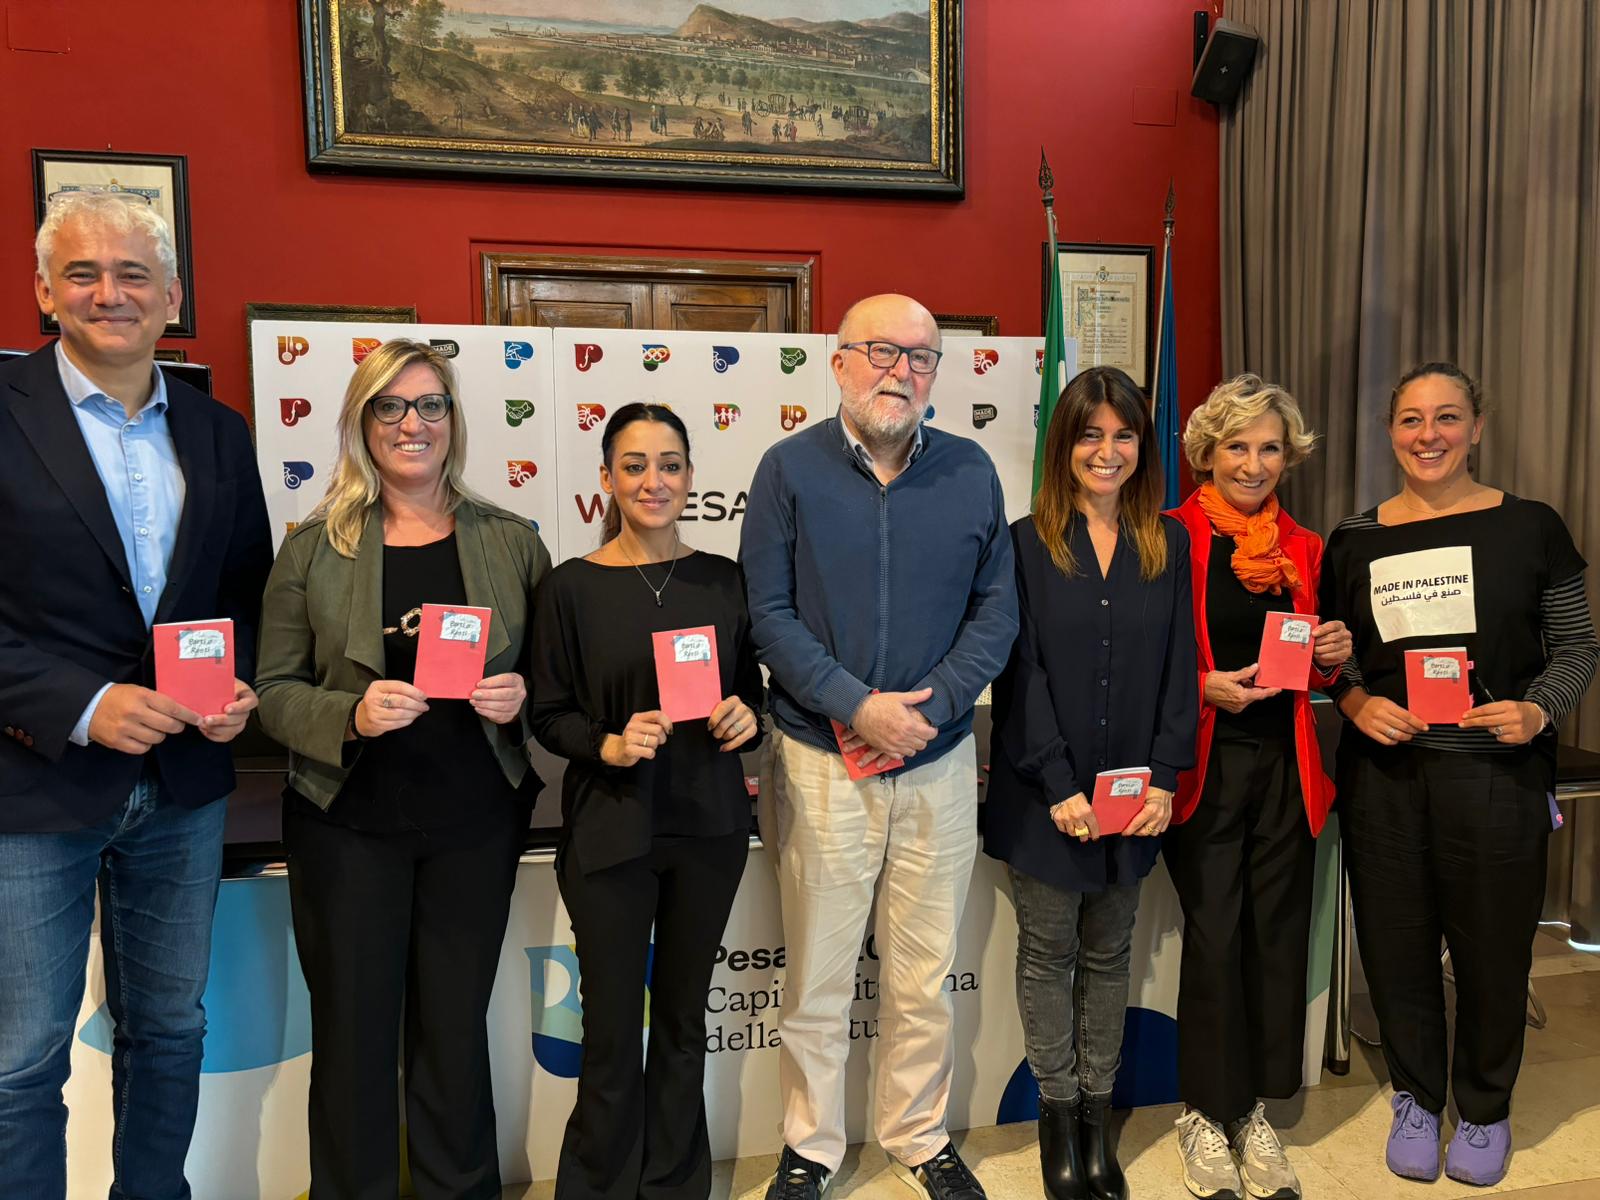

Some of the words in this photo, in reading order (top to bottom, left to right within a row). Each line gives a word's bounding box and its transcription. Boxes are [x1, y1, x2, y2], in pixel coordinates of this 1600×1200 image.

[1374, 582, 1400, 595] MADE
[1403, 580, 1413, 589] IN
[1416, 575, 1468, 587] PALESTINE
[1441, 588, 1461, 598] صنع
[1381, 591, 1421, 606] فلسطين
[1424, 590, 1438, 602] في
[713, 945, 786, 971] Pesa
[705, 980, 784, 1017] Capi
[705, 1021, 782, 1053] della
